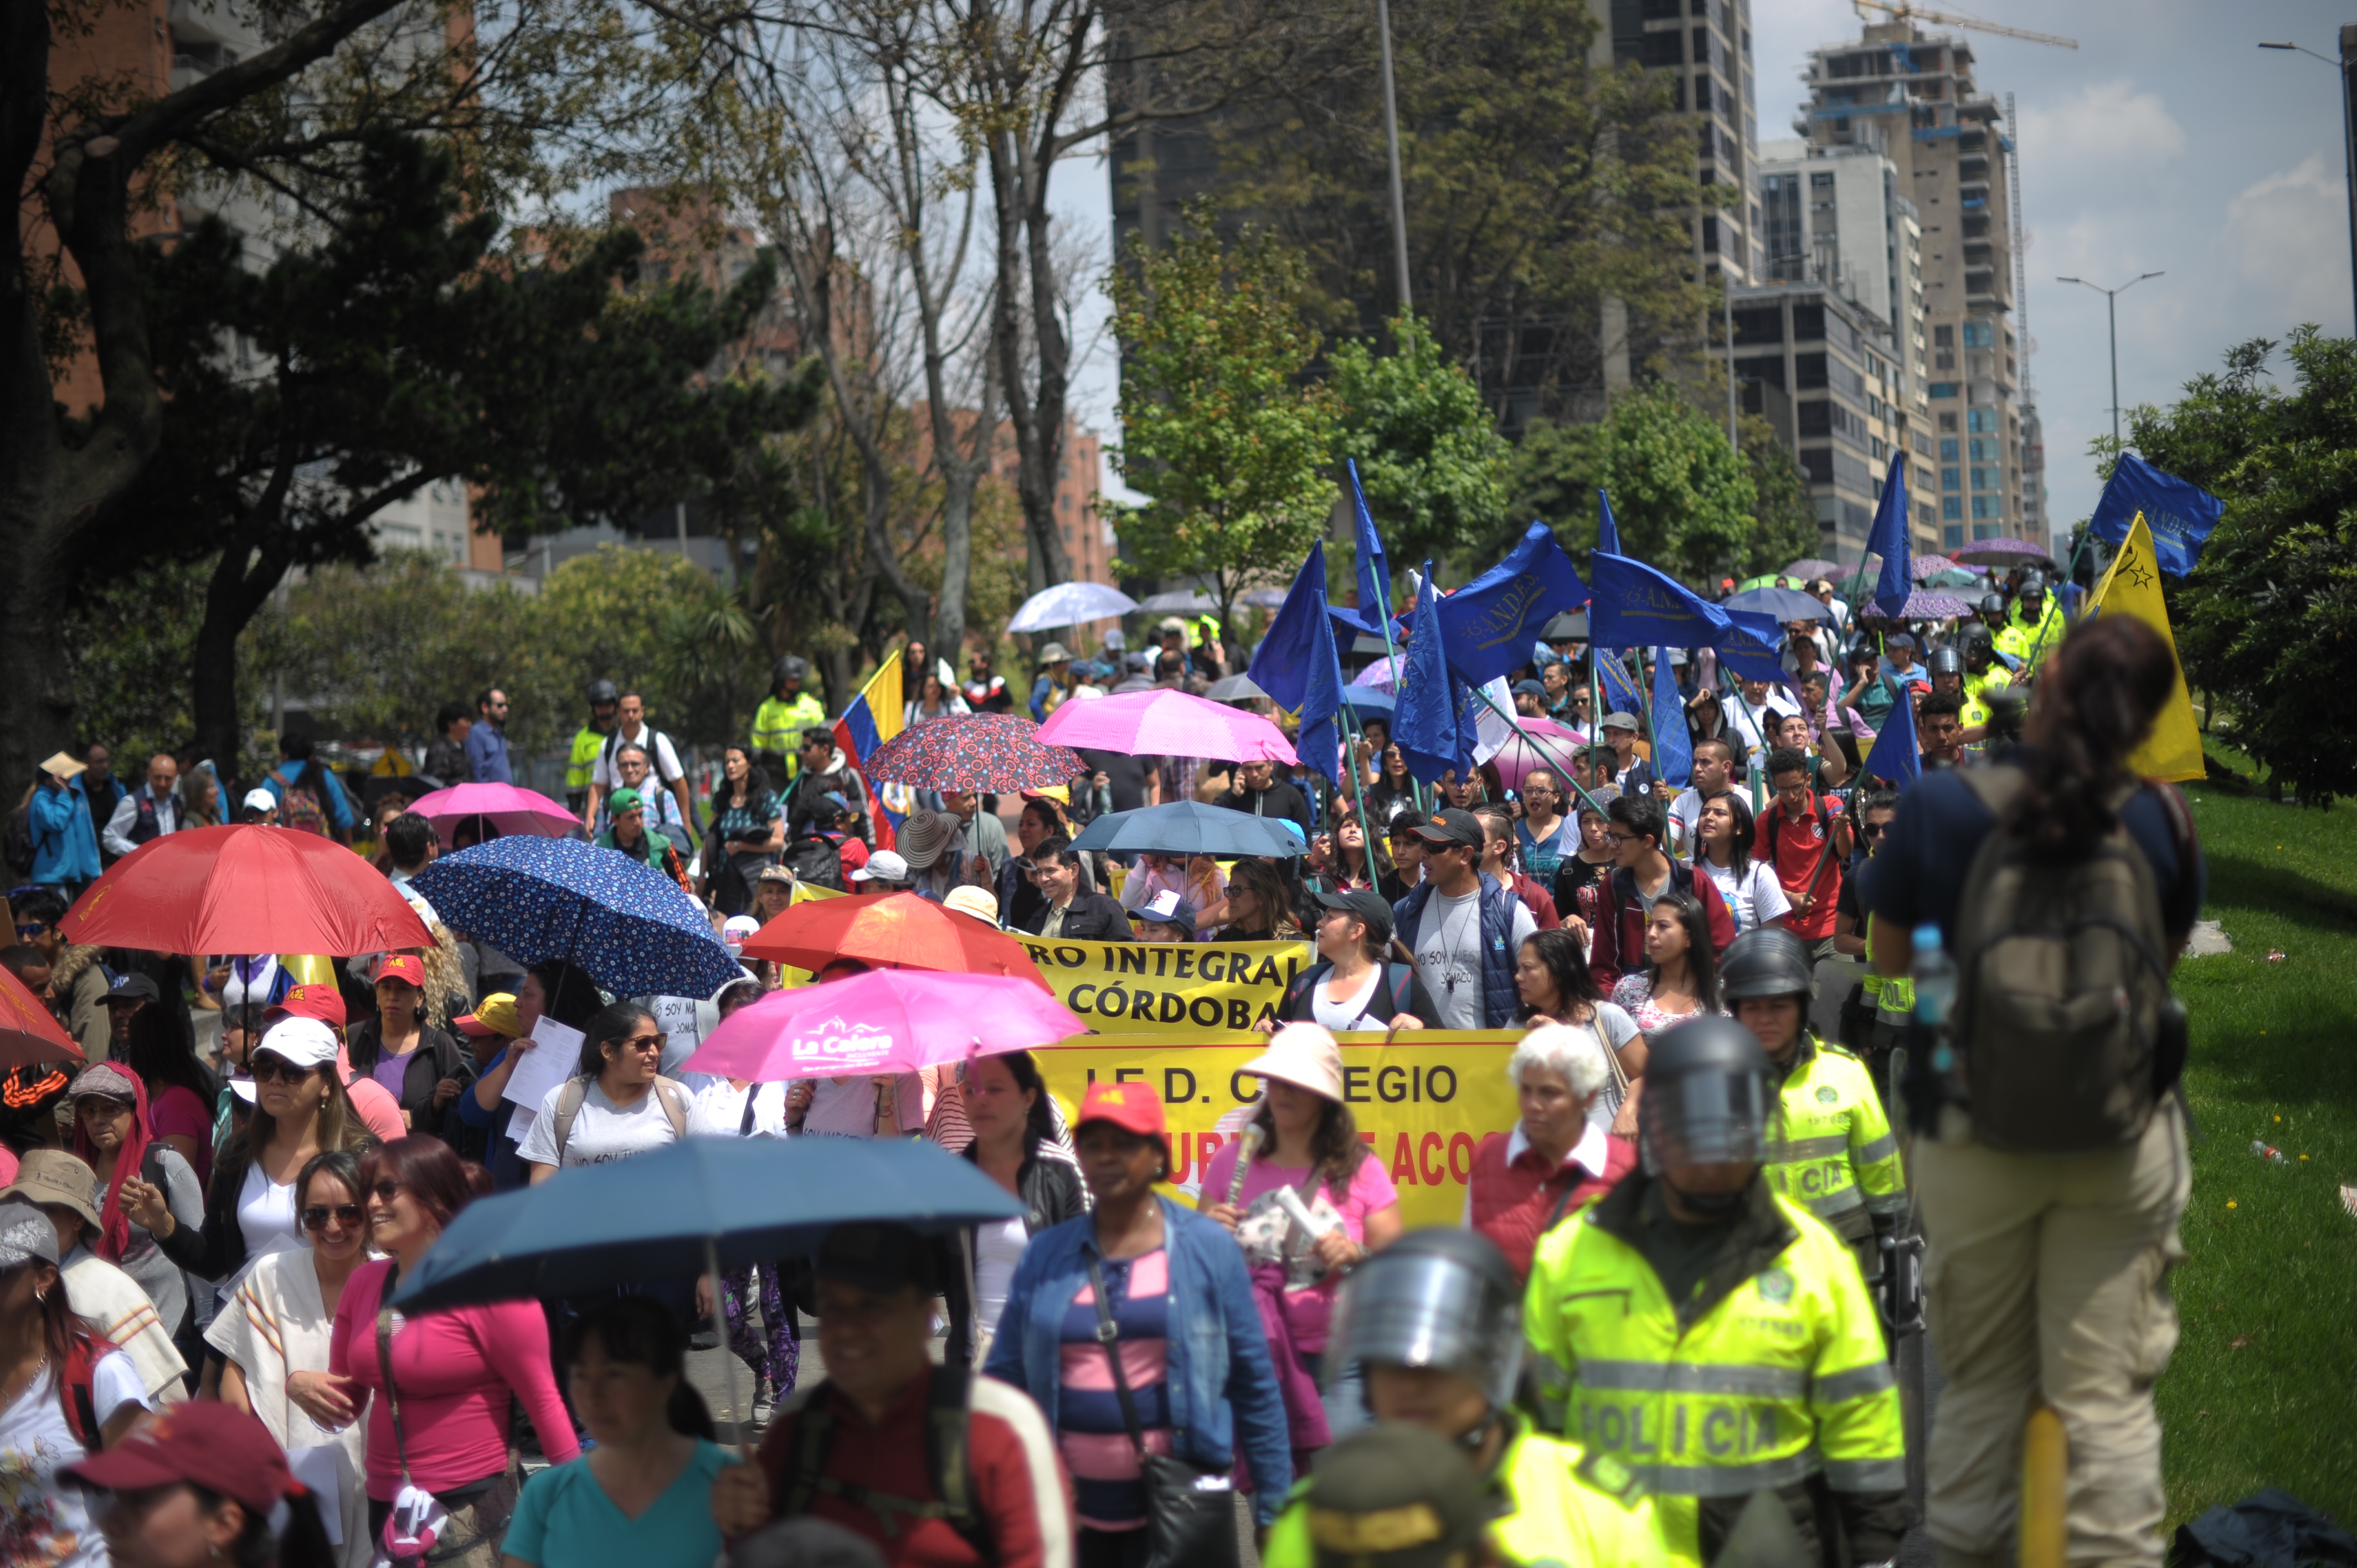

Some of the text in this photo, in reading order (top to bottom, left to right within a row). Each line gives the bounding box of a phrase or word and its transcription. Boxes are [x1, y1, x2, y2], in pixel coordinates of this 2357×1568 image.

[1429, 950, 1447, 966] SOY
[1440, 971, 1473, 984] JOMACO
[665, 1003, 682, 1017] SOY
[792, 1034, 893, 1055] La Calera
[1230, 1065, 1458, 1103] CEGIO
[1582, 1402, 1777, 1456] POLICIA
